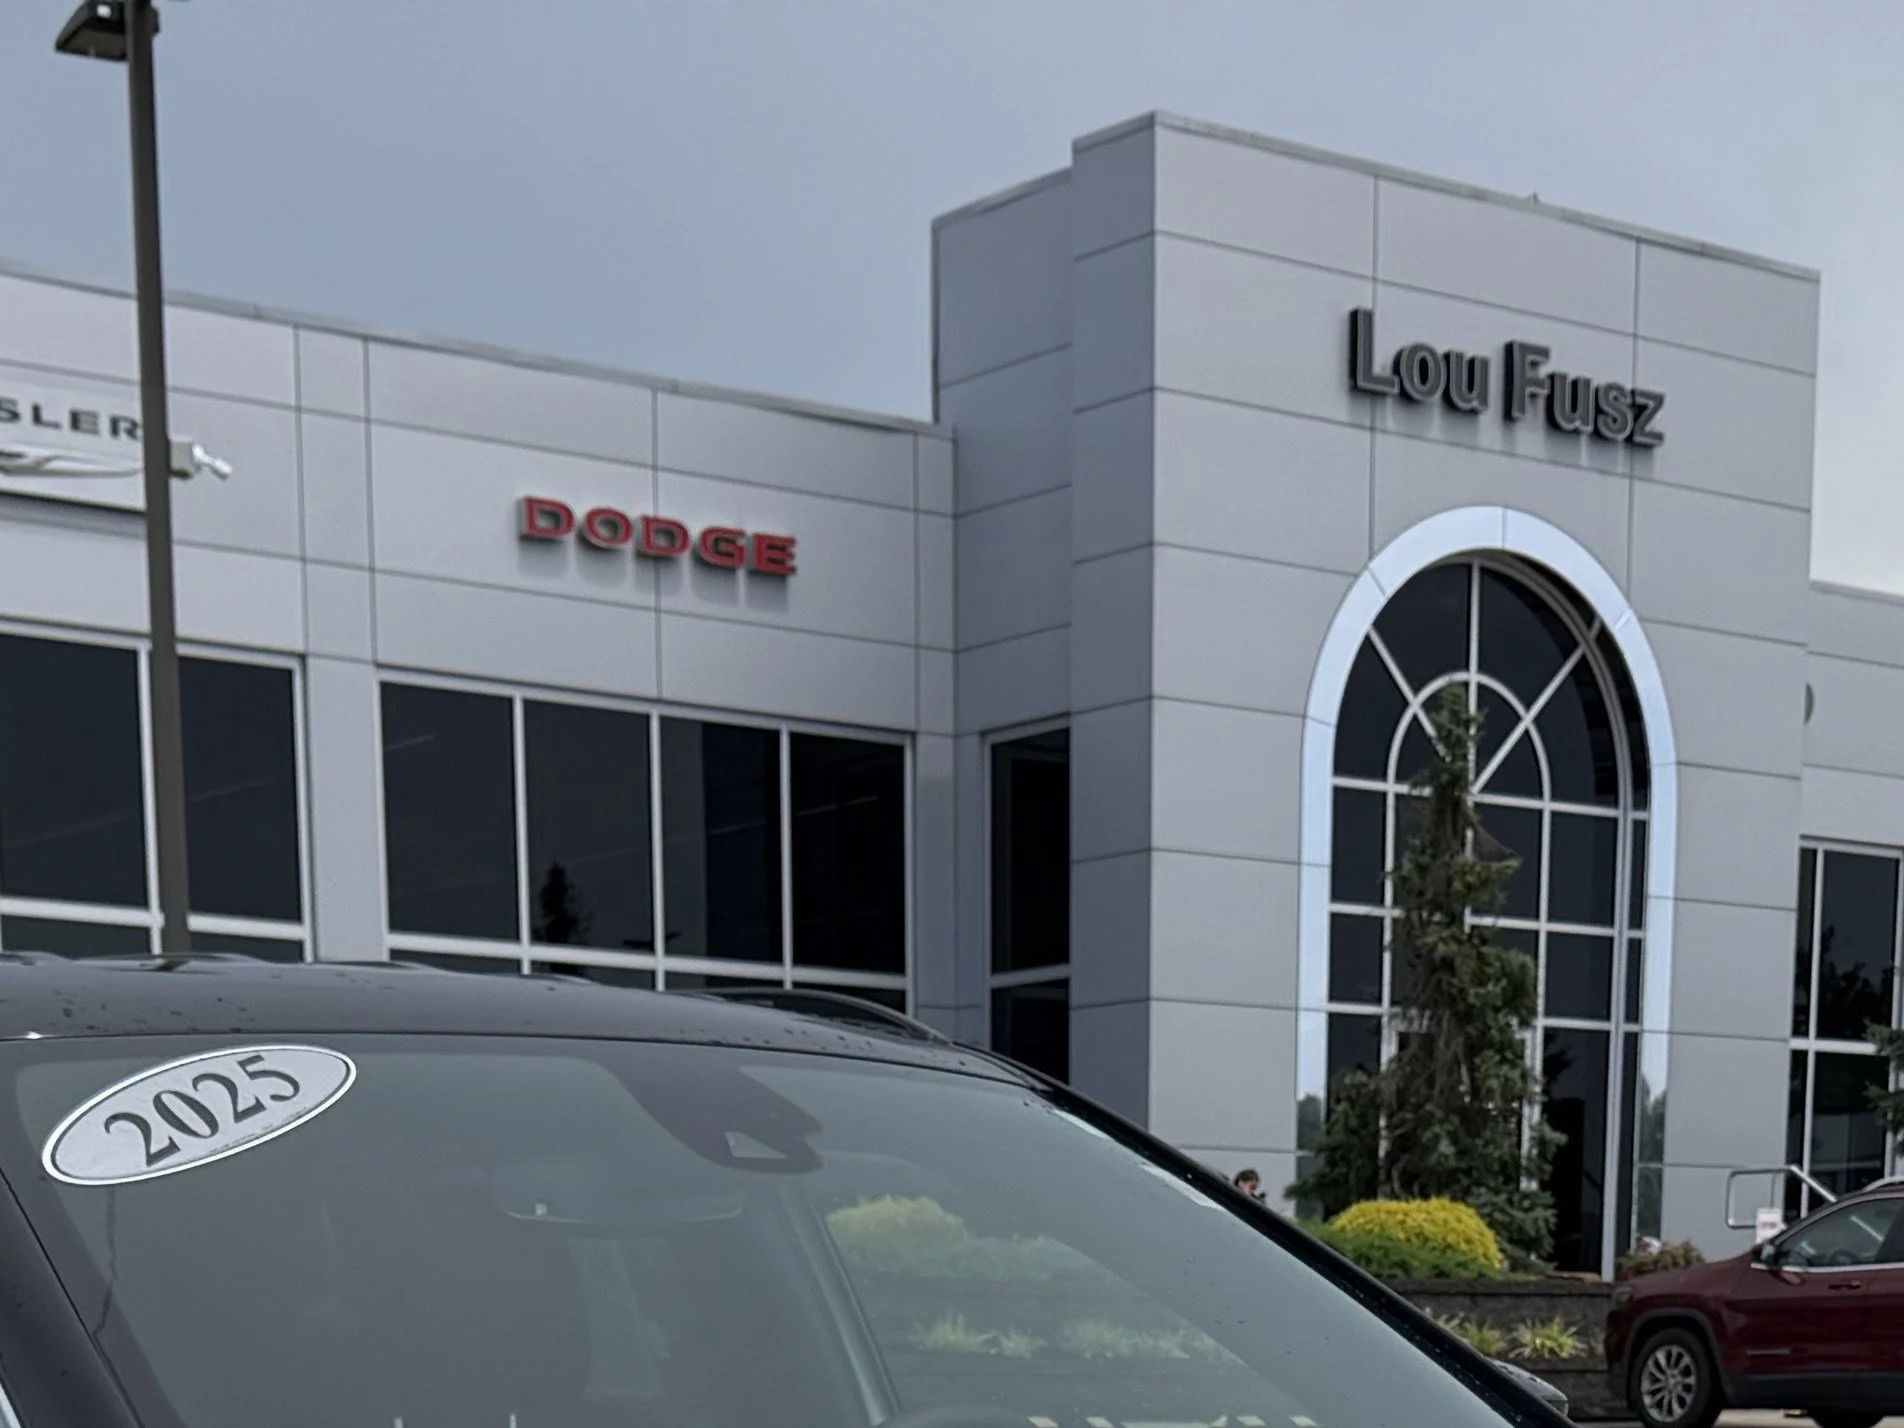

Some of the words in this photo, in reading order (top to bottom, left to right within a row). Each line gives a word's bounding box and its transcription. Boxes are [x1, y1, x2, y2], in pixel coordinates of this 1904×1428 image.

[1348, 306, 1491, 415] Lou
[1503, 340, 1666, 447] Fusz
[517, 496, 797, 576] DODGE
[104, 1054, 300, 1168] 2025
